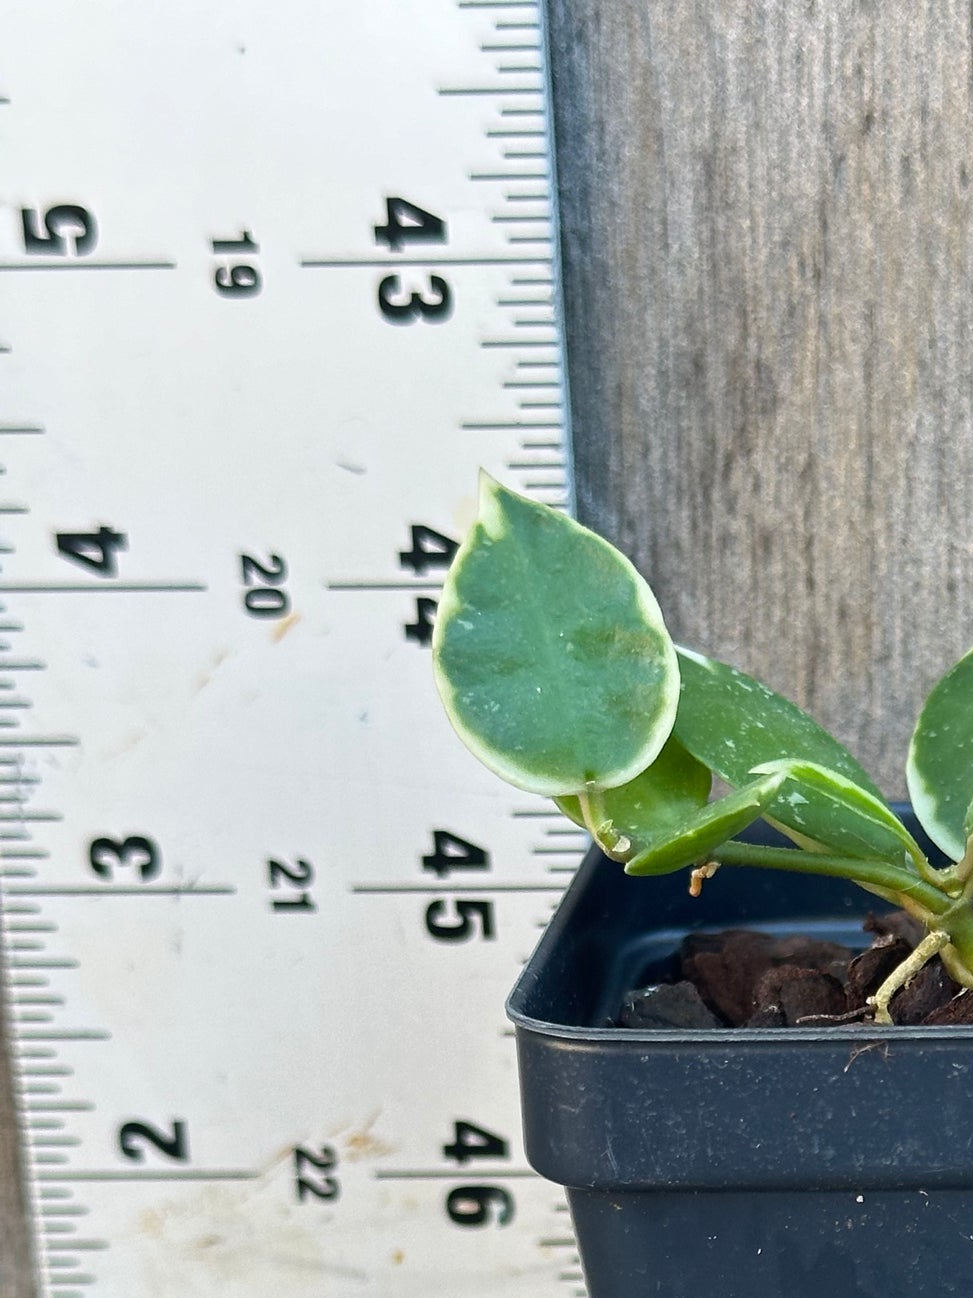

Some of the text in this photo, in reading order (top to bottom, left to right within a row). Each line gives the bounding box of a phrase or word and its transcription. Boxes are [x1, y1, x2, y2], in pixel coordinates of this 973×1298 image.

[21, 204, 95, 253] 5
[212, 231, 260, 296] 19
[373, 197, 453, 323] 43
[55, 526, 125, 576] 4
[240, 554, 289, 618] 20
[89, 835, 159, 880] 3
[268, 859, 315, 912] 21
[421, 830, 495, 944] 45
[118, 1121, 188, 1162] 2
[292, 1147, 339, 1202] 22
[442, 1120, 515, 1229] 46
